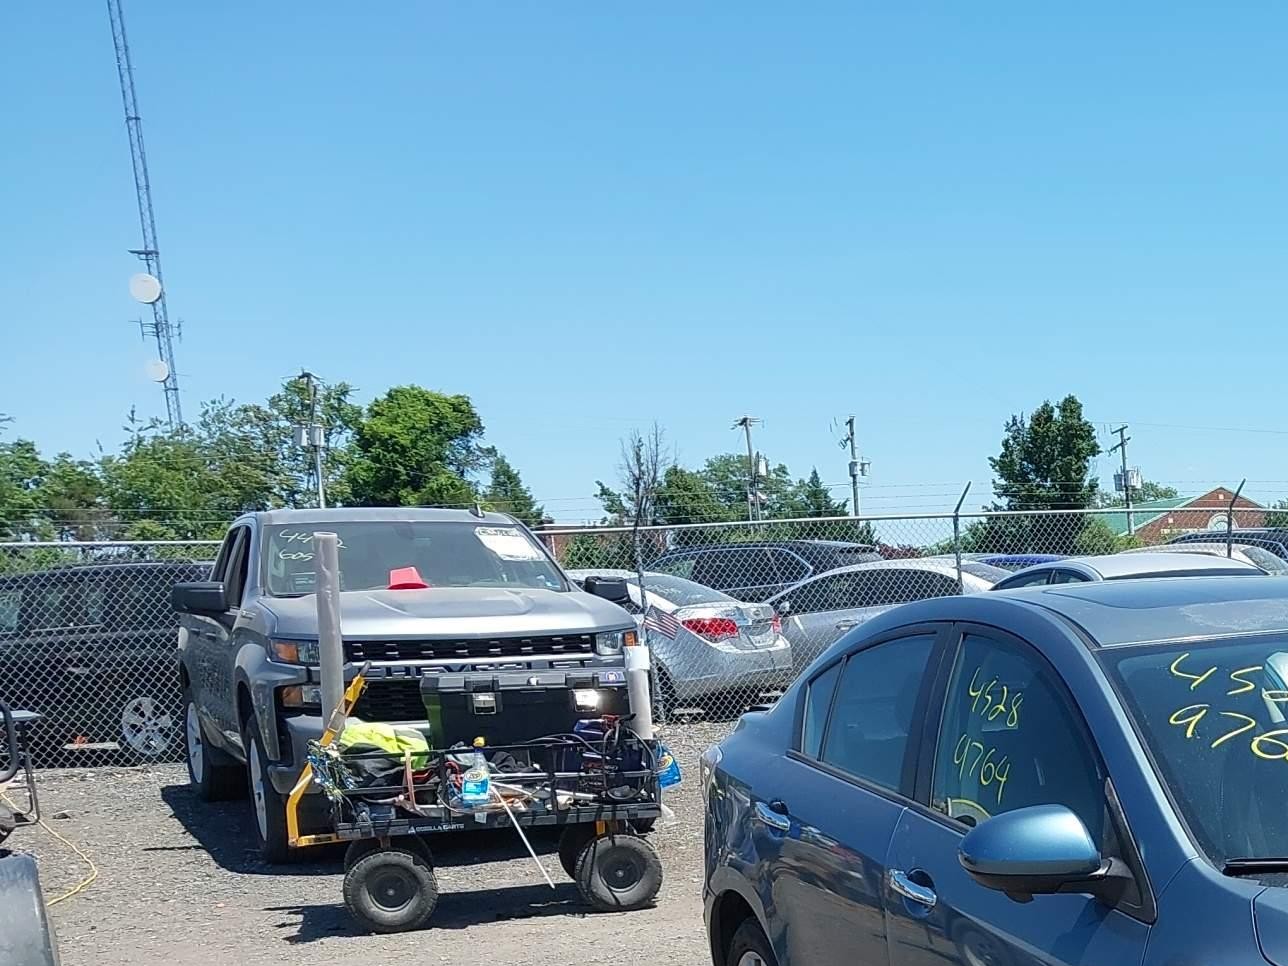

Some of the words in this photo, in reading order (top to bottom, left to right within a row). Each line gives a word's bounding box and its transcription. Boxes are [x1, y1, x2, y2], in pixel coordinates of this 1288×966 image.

[279, 528, 348, 549] 442
[968, 666, 1024, 727] 4528
[953, 733, 1010, 806] 9764
